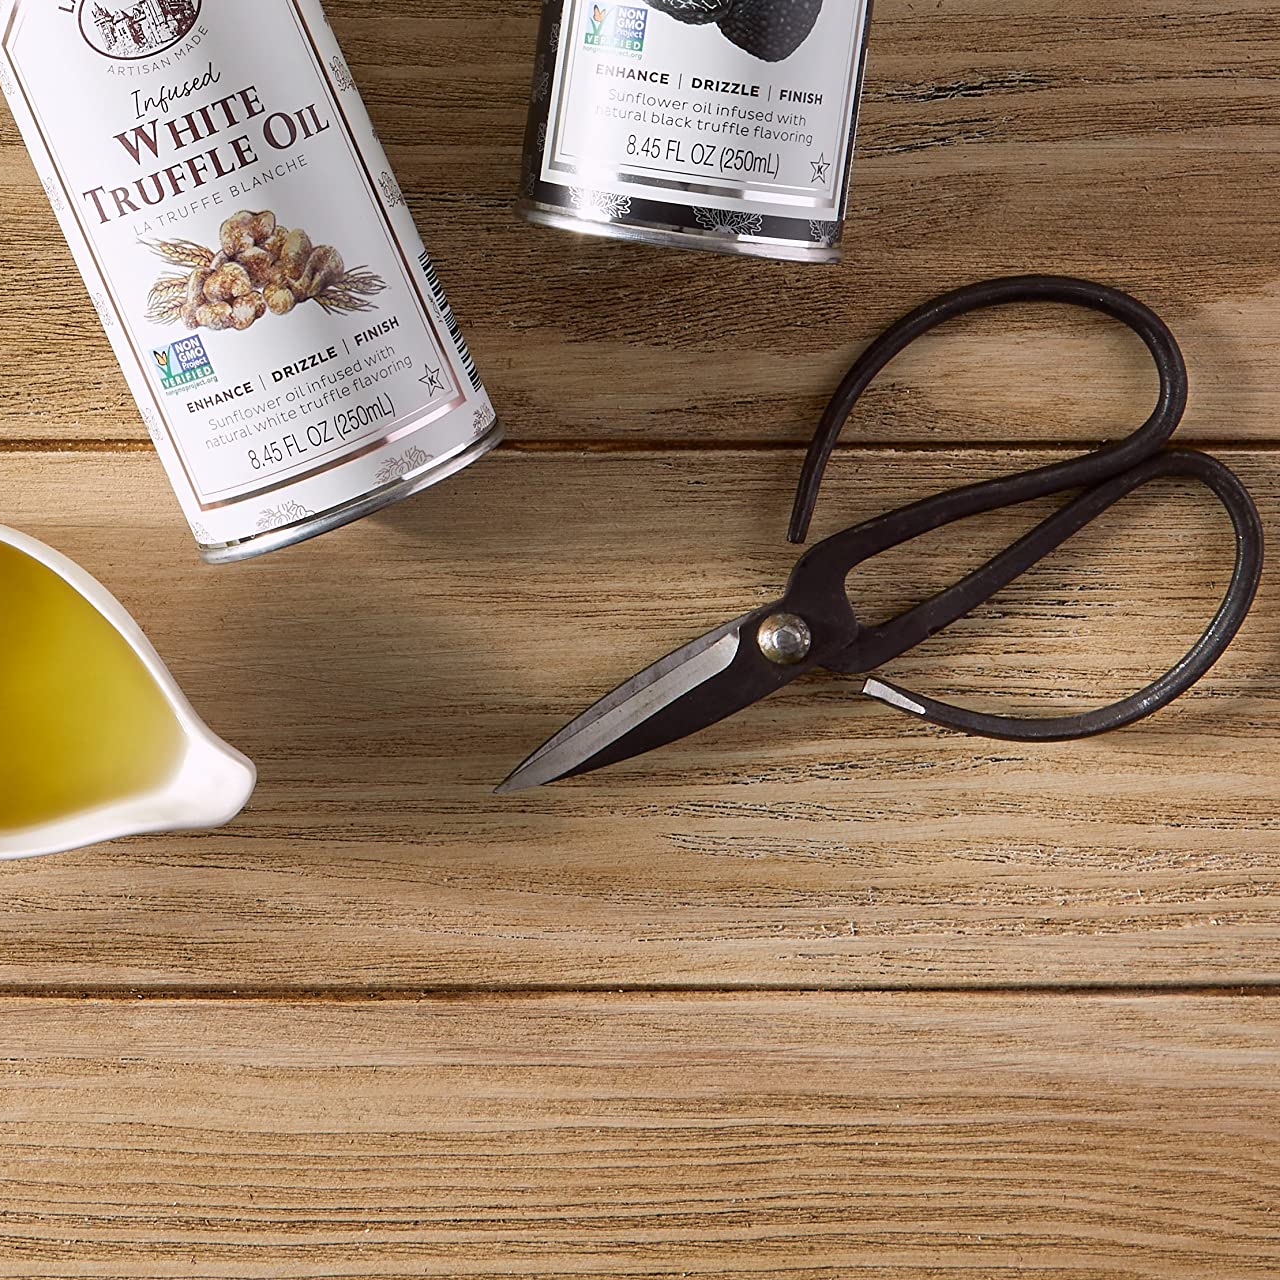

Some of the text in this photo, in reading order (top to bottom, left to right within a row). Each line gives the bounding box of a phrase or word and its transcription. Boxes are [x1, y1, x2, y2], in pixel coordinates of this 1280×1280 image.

[616, 20, 645, 31] GMO
[618, 7, 646, 21] NON
[106, 25, 209, 77] ARTISAN MADE
[131, 61, 221, 120] Infused
[595, 63, 671, 85] ENHANCE
[691, 77, 761, 98] DRIZZLE
[779, 89, 824, 106] FINISH
[112, 85, 266, 166] WHITE
[595, 105, 814, 148] natural black truffle flavoring
[608, 88, 807, 127] Sunflower oil infused with
[626, 134, 782, 180] 8.45 FL OZ (250mL)
[82, 134, 259, 225] TRUFFLE
[133, 154, 309, 236] LA TRUFFE BLANCHE
[174, 337, 200, 354] NON
[178, 347, 204, 362] GMO
[182, 357, 208, 371] Project
[186, 381, 254, 414] ENHANCE
[272, 346, 338, 383] DRIZZLE
[354, 315, 400, 347] FINISH
[163, 367, 212, 389] VERIFIED
[165, 375, 219, 396] nongmoproject.org
[208, 345, 396, 431] Sunflower oil infused with
[205, 354, 413, 449] natural white truffle flavoring
[247, 392, 397, 470] 8.45 FL OZ (250mL)
